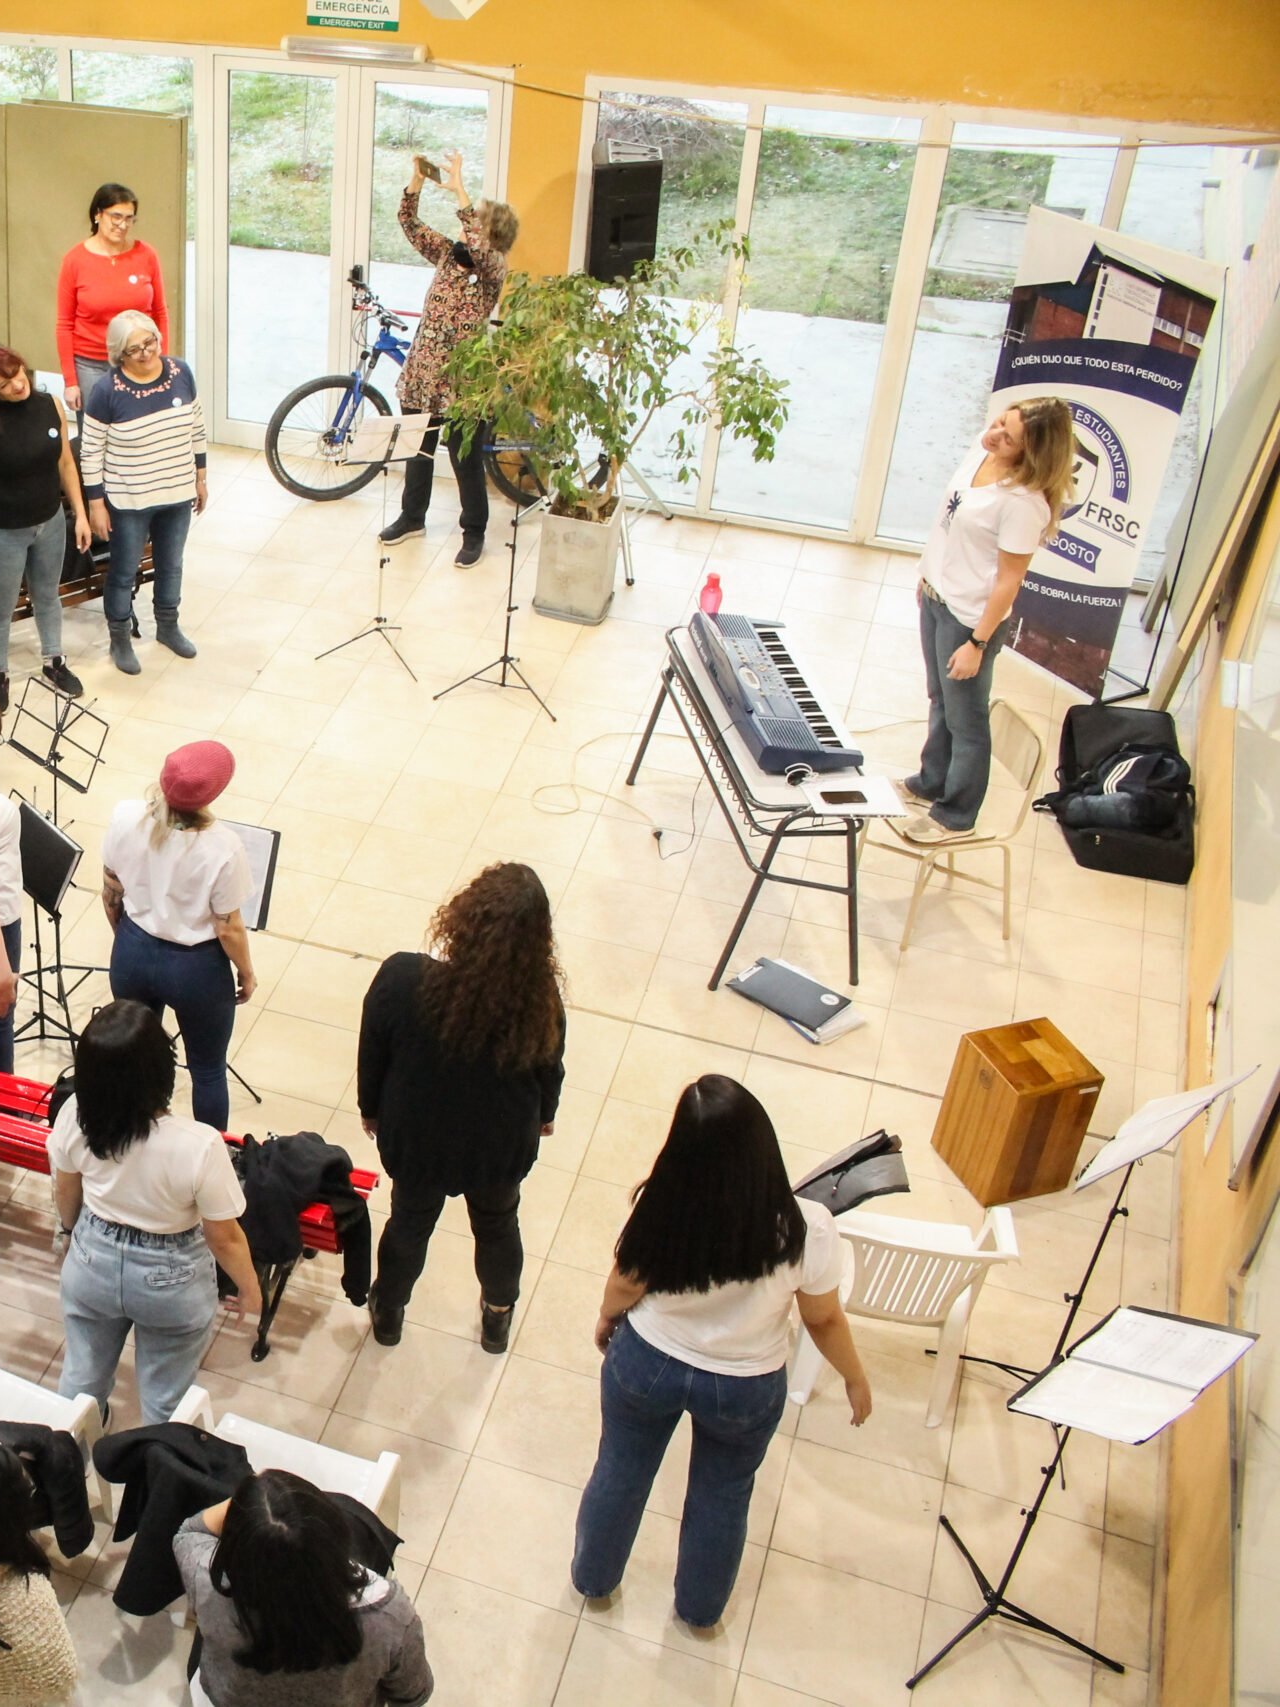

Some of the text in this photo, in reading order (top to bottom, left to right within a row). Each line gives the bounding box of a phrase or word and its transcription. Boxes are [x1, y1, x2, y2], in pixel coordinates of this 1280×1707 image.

[315, 1, 390, 15] EMERGENCIA
[319, 17, 385, 30] EMERGENCY EXIT
[1042, 355, 1062, 365] DIJO
[1063, 355, 1082, 366] QUE
[1084, 357, 1110, 369] TODO
[1111, 362, 1135, 375] ESTA
[1135, 368, 1183, 392] PERDIDO?
[1075, 409, 1126, 489] ESTUDIANTES
[1084, 501, 1140, 539] FRSC
[1047, 533, 1095, 564] GOSTO
[1021, 580, 1039, 592] NOS
[1040, 587, 1070, 601] SOBRA
[1071, 594, 1082, 603] LA
